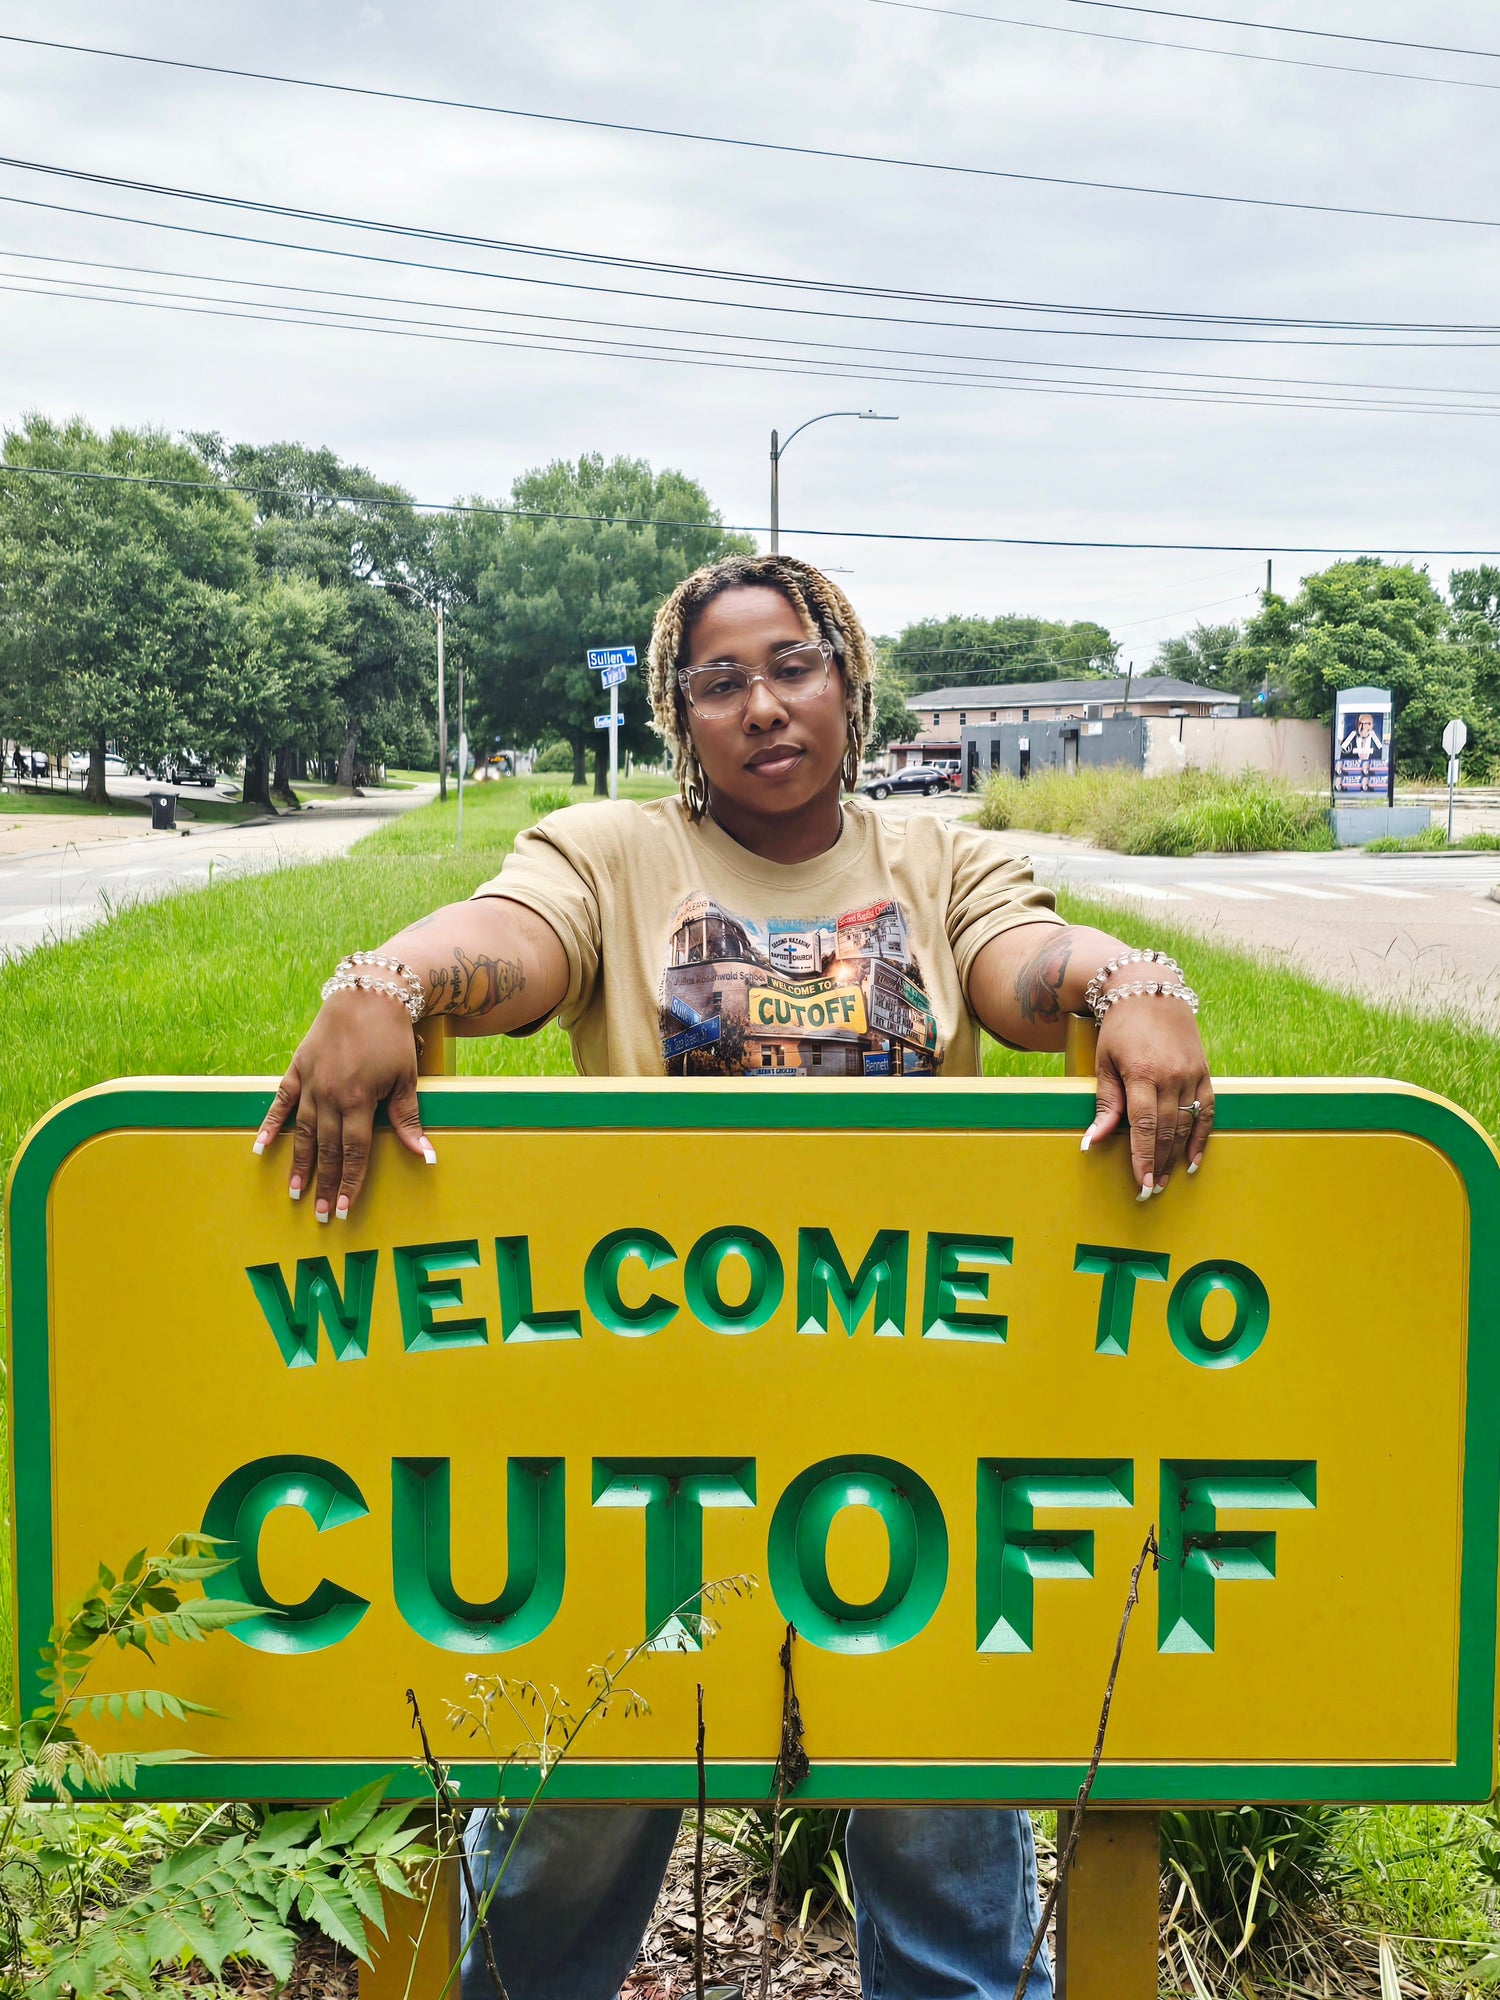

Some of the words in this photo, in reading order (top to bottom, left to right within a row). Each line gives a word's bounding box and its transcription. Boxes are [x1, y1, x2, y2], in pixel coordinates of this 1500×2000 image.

[591, 651, 623, 666] Sullen
[839, 915, 857, 926] Second
[857, 908, 875, 922] Baptist
[771, 952, 789, 961] BAPTIST
[696, 971, 738, 984] Rosenwald
[739, 971, 766, 983] School
[771, 978, 817, 996] WELCOME
[818, 981, 832, 991] TO
[758, 995, 856, 1027] CUTOFF
[865, 1058, 889, 1072] Bennett
[245, 1225, 1013, 1369] WELCOME
[1073, 1243, 1271, 1370] TO
[200, 1453, 1318, 1656] CUTOFF
